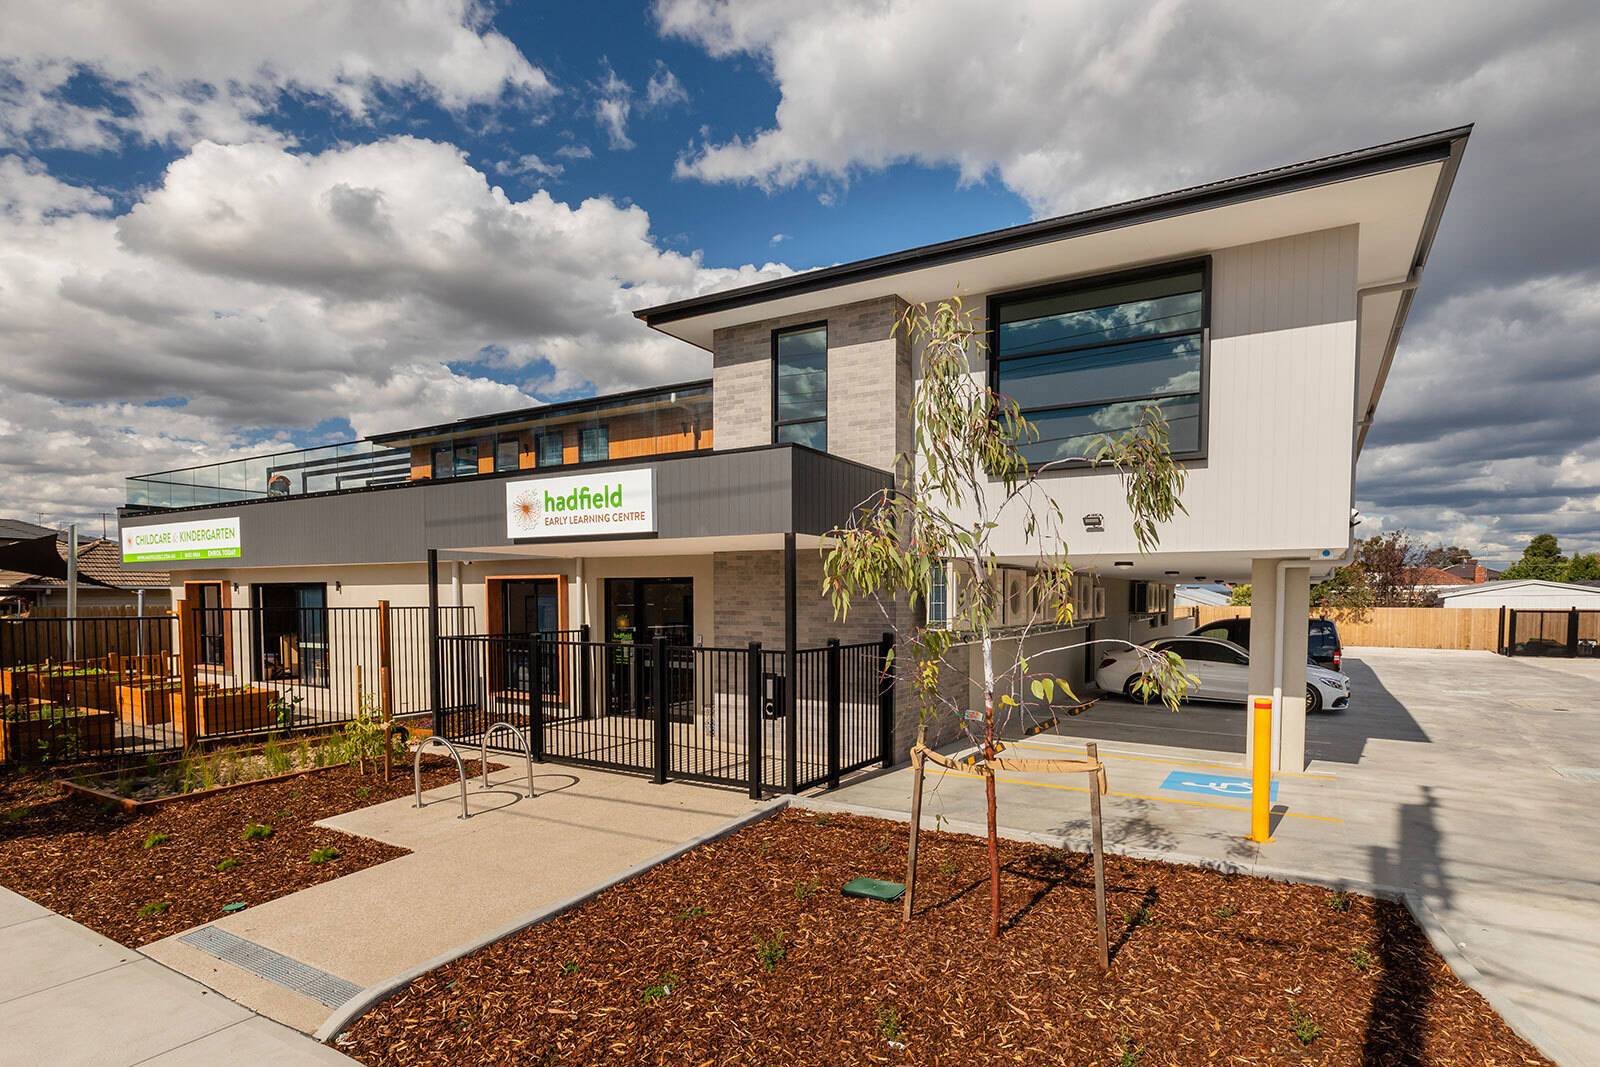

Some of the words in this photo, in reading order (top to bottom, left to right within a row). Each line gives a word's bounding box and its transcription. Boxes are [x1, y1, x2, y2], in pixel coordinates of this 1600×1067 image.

[544, 483, 622, 512] hadfield
[544, 516, 568, 526] EARLY
[569, 513, 611, 525] LEARNING
[611, 511, 646, 522] CENTRE
[135, 532, 171, 546] CHILDCARE
[179, 527, 235, 543] KINDERGARTEN
